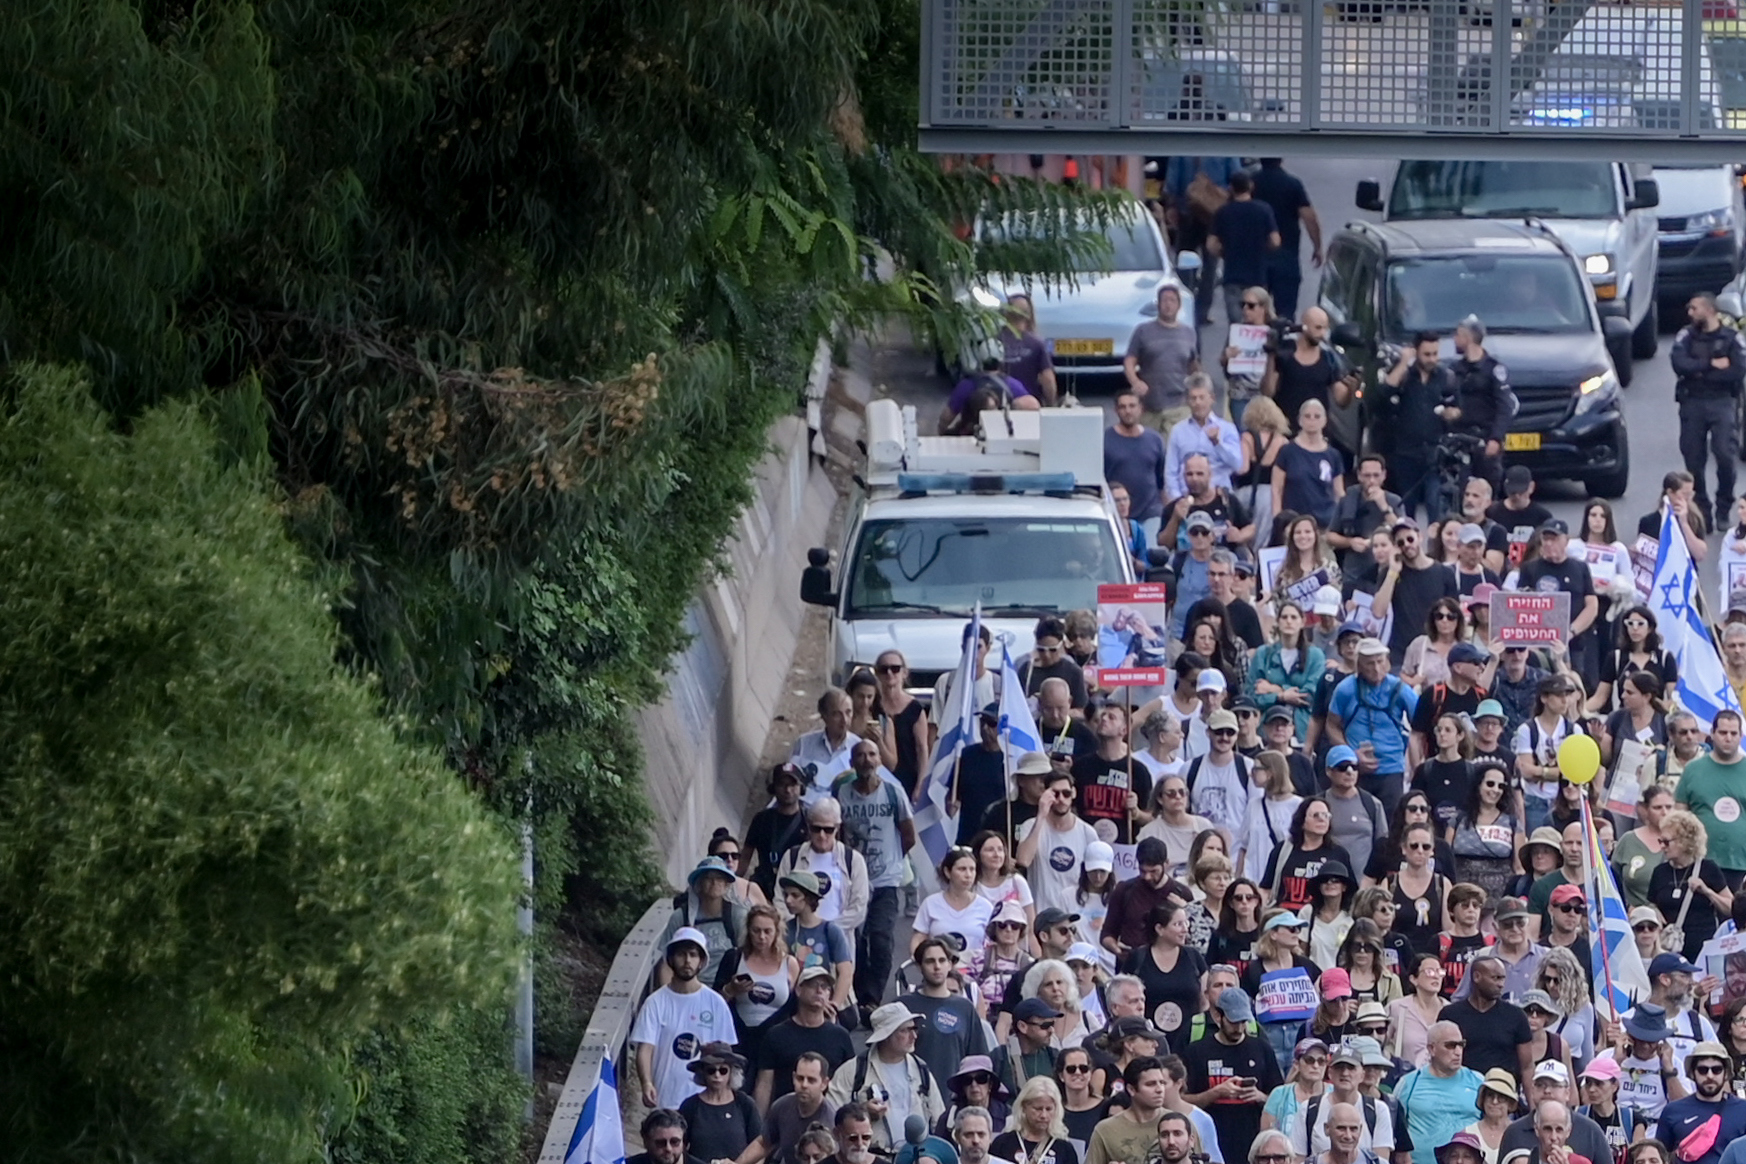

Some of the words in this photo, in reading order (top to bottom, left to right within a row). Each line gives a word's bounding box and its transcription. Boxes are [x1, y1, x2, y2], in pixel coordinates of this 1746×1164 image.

[1508, 597, 1551, 609] החזירו
[1518, 613, 1539, 624] את
[1502, 628, 1556, 640] החטופים
[1622, 1081, 1637, 1093] עם
[1638, 1083, 1658, 1096] ביחד
